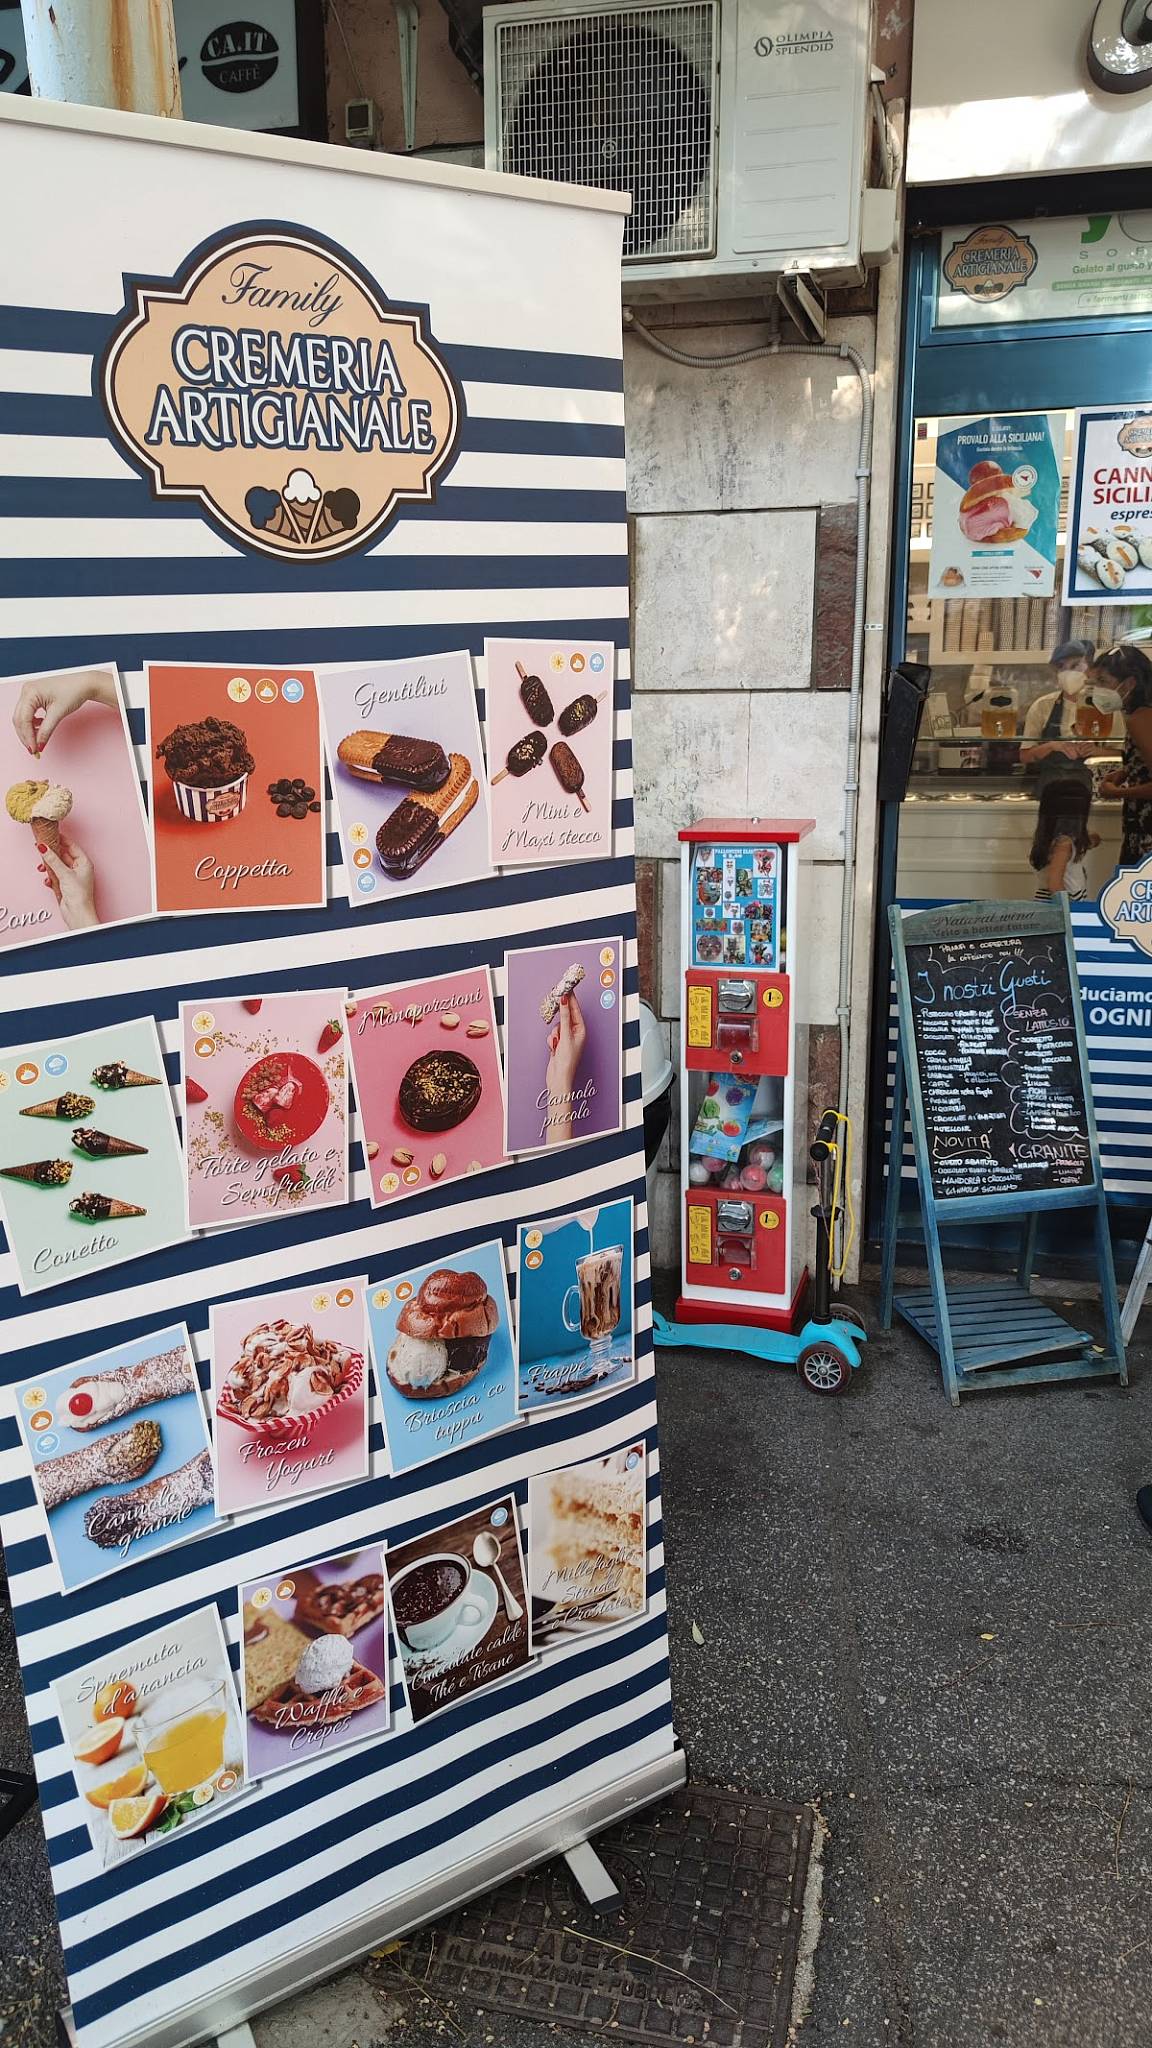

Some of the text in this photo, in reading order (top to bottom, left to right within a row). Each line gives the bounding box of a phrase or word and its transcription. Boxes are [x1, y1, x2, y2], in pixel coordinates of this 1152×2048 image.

[207, 31, 268, 57] CA.IT
[775, 42, 834, 56] SPLENDID
[776, 31, 833, 43] OLIMPIA
[953, 258, 1028, 278] ARTIGIANALE
[963, 246, 1020, 263] CREMERIA
[1072, 264, 1104, 273] Gelato
[1106, 263, 1115, 272] al
[221, 262, 343, 327] Family
[173, 326, 405, 396] CREMERIA
[147, 386, 435, 453] ARTIGIANALE
[957, 432, 1045, 445] PROVALO ALLA SICILIANA!
[353, 675, 448, 718] Gentilini
[522, 799, 582, 823] Mini e
[501, 828, 602, 852] Maxi stecco
[193, 855, 293, 889] Coppetta
[0, 904, 52, 934] Cono
[943, 976, 997, 1002] nostri
[1000, 961, 1052, 1014] Gusti
[357, 987, 483, 1035] Monoporzioni
[1013, 1008, 1048, 1019] SENZA
[1026, 1017, 1070, 1031] LATTOSIO
[1089, 1006, 1151, 1027] OGNI
[535, 1085, 599, 1112] Cannolo
[539, 1102, 593, 1137] piccolo
[199, 1143, 337, 1181] Torte gelato e
[1018, 1143, 1089, 1160] GRANITE
[220, 1167, 337, 1206] Semifreddi
[31, 1232, 120, 1274] Conetto
[527, 1356, 588, 1385] Frappé
[403, 1395, 480, 1433] Brioscia
[434, 1412, 484, 1443] tuppu
[238, 1434, 311, 1465] Frozen
[264, 1448, 335, 1492] Yogurt
[118, 1500, 195, 1557] grande
[561, 1569, 624, 1603] Strudel
[75, 1640, 183, 1702] Spremuta
[102, 1654, 207, 1715] d'arancia
[430, 1653, 514, 1702] Thé e Tisane
[275, 1685, 363, 1729] Waffle e
